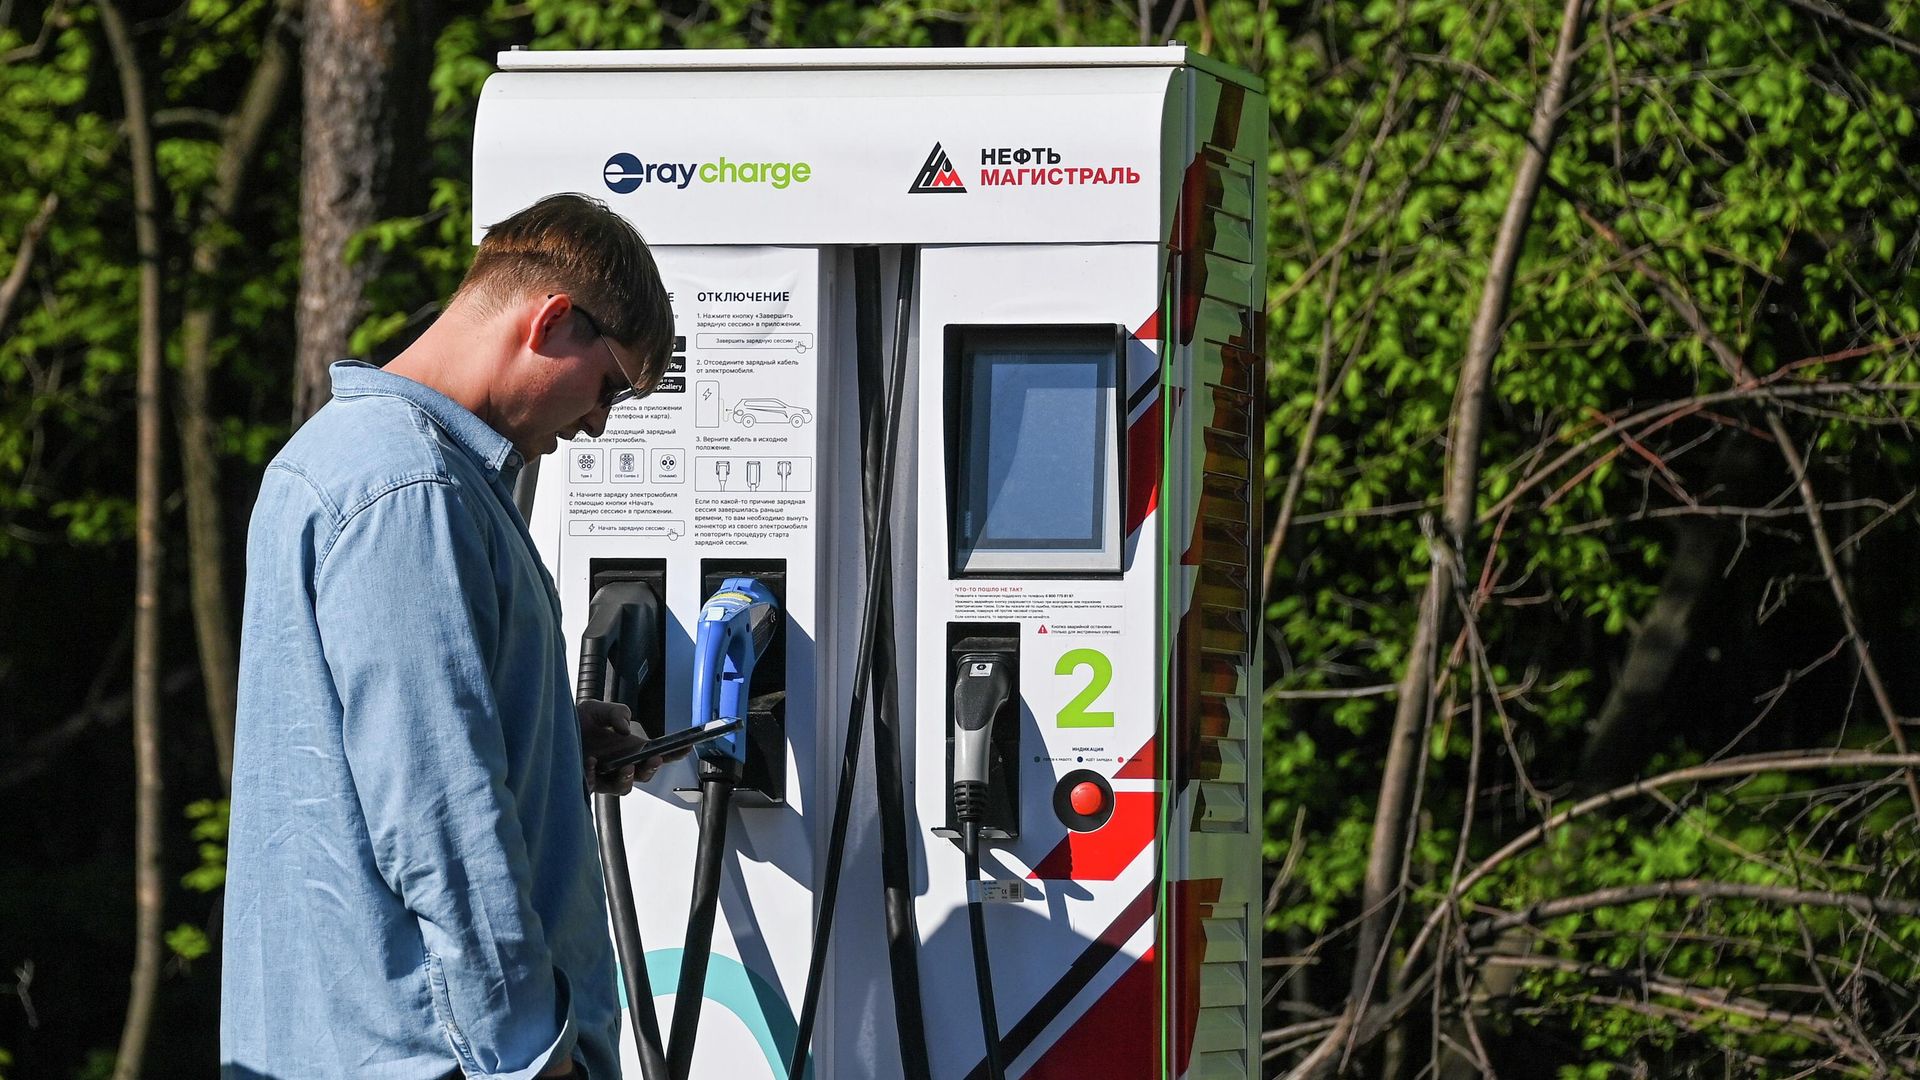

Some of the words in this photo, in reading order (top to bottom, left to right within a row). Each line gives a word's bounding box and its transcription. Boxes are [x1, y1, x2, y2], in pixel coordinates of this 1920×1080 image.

[981, 148, 1061, 165] НЕФТЬ
[980, 167, 1140, 186] МАГИСТРАЛЬ
[697, 292, 790, 302] ОТКЛЮЧЕНИЕ
[670, 363, 682, 371] Play
[1055, 648, 1114, 728] 2
